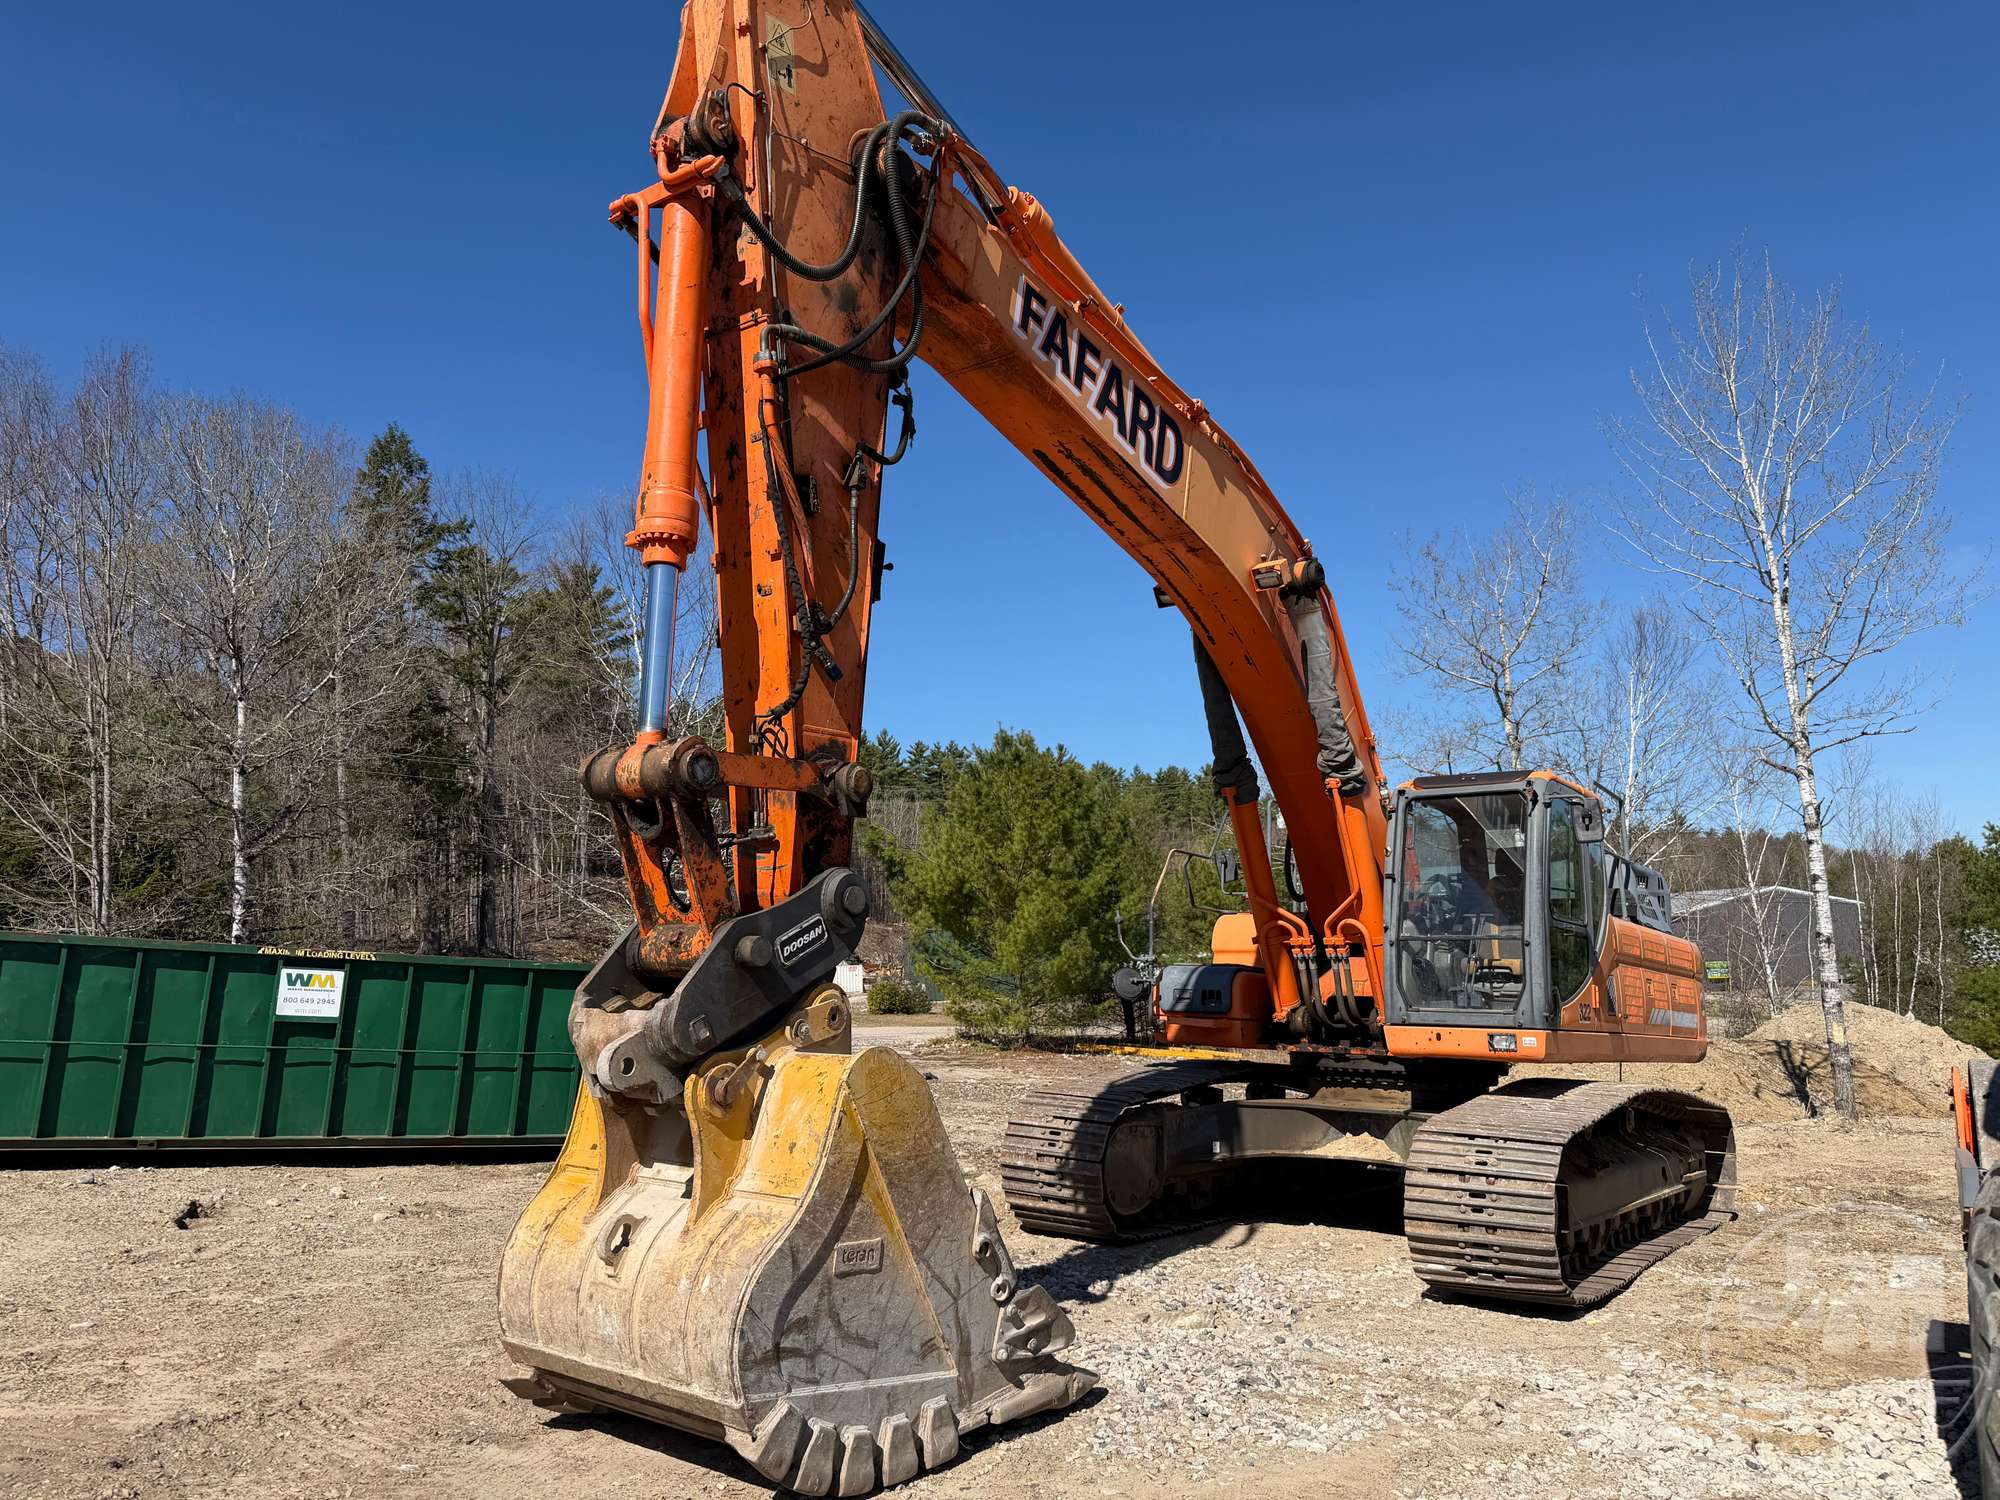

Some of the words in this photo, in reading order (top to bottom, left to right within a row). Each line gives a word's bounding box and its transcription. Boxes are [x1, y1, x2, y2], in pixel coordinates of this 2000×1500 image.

[1012, 275, 1184, 488] FAFARD
[783, 925, 823, 957] DOOSAN
[264, 947, 305, 957] MAXIM
[306, 949, 344, 959] LOADING
[345, 951, 371, 960] LEVEL
[286, 973, 336, 988] WM
